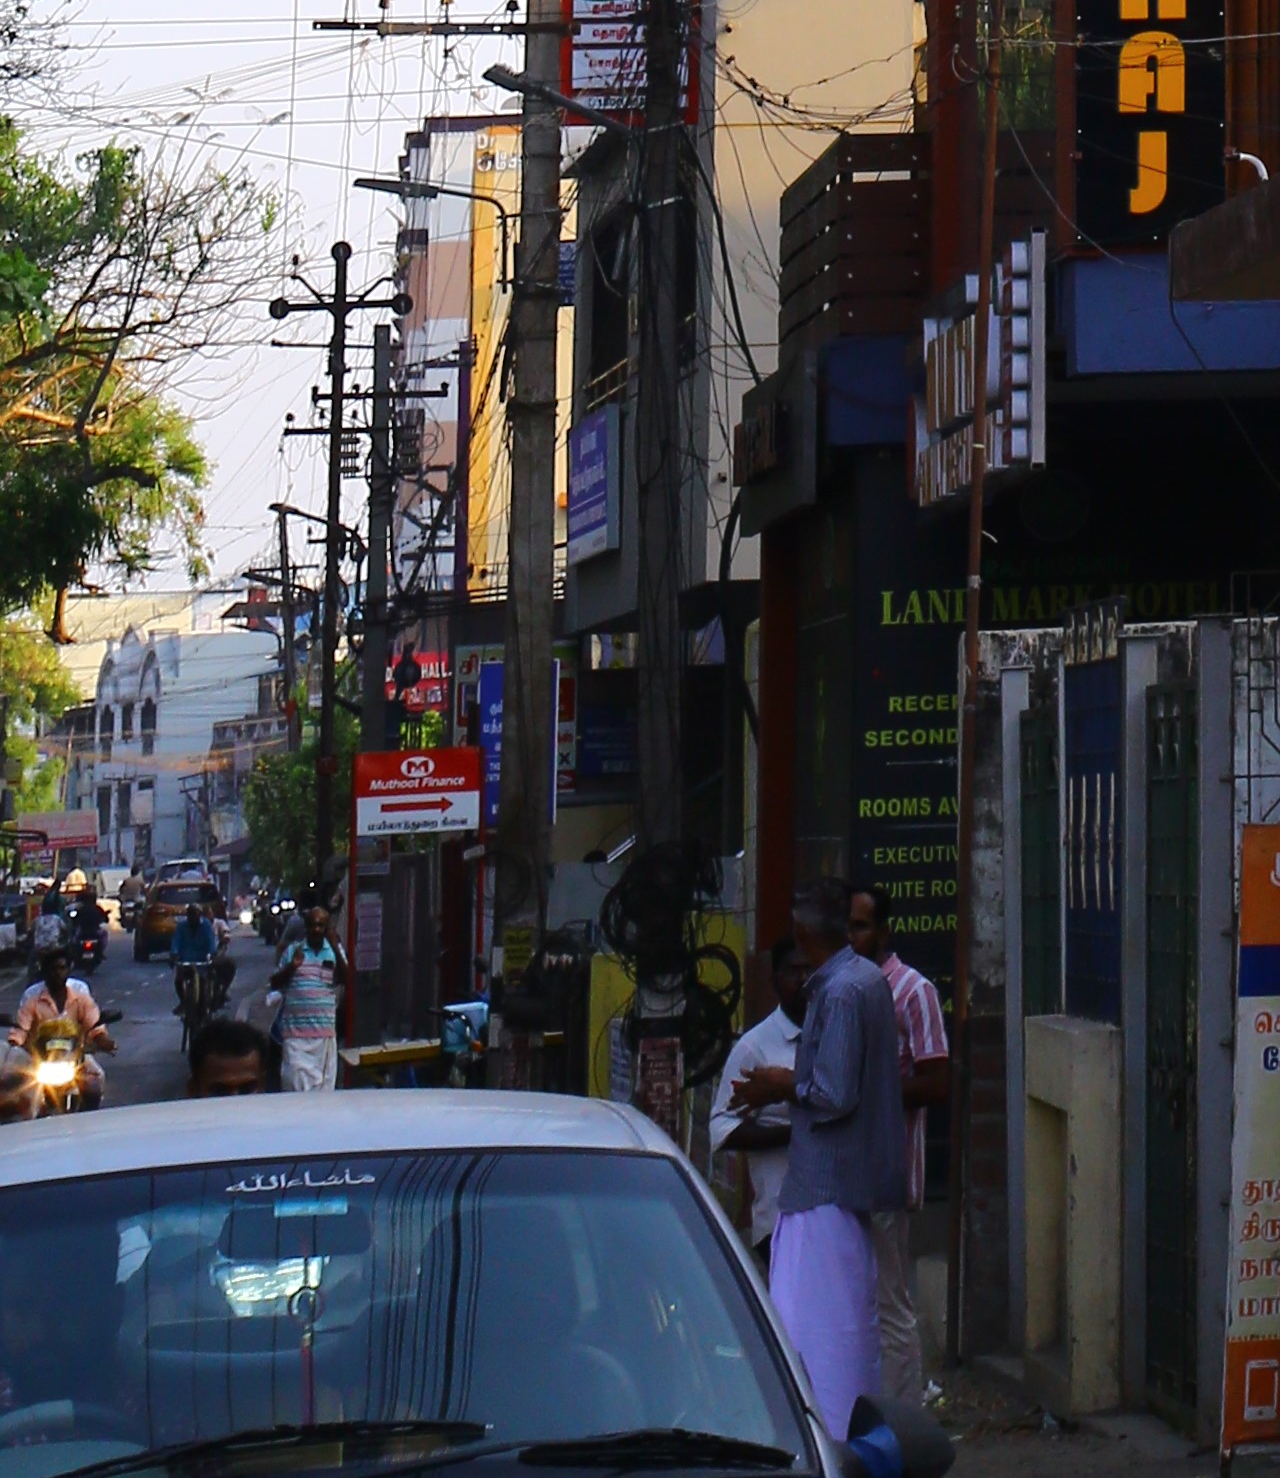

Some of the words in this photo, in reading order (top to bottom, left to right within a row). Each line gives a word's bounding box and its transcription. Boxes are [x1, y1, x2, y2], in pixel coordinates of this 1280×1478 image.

[368, 778, 421, 791] Muthoot
[421, 775, 466, 788] Finance
[859, 796, 931, 818] ROOMS
